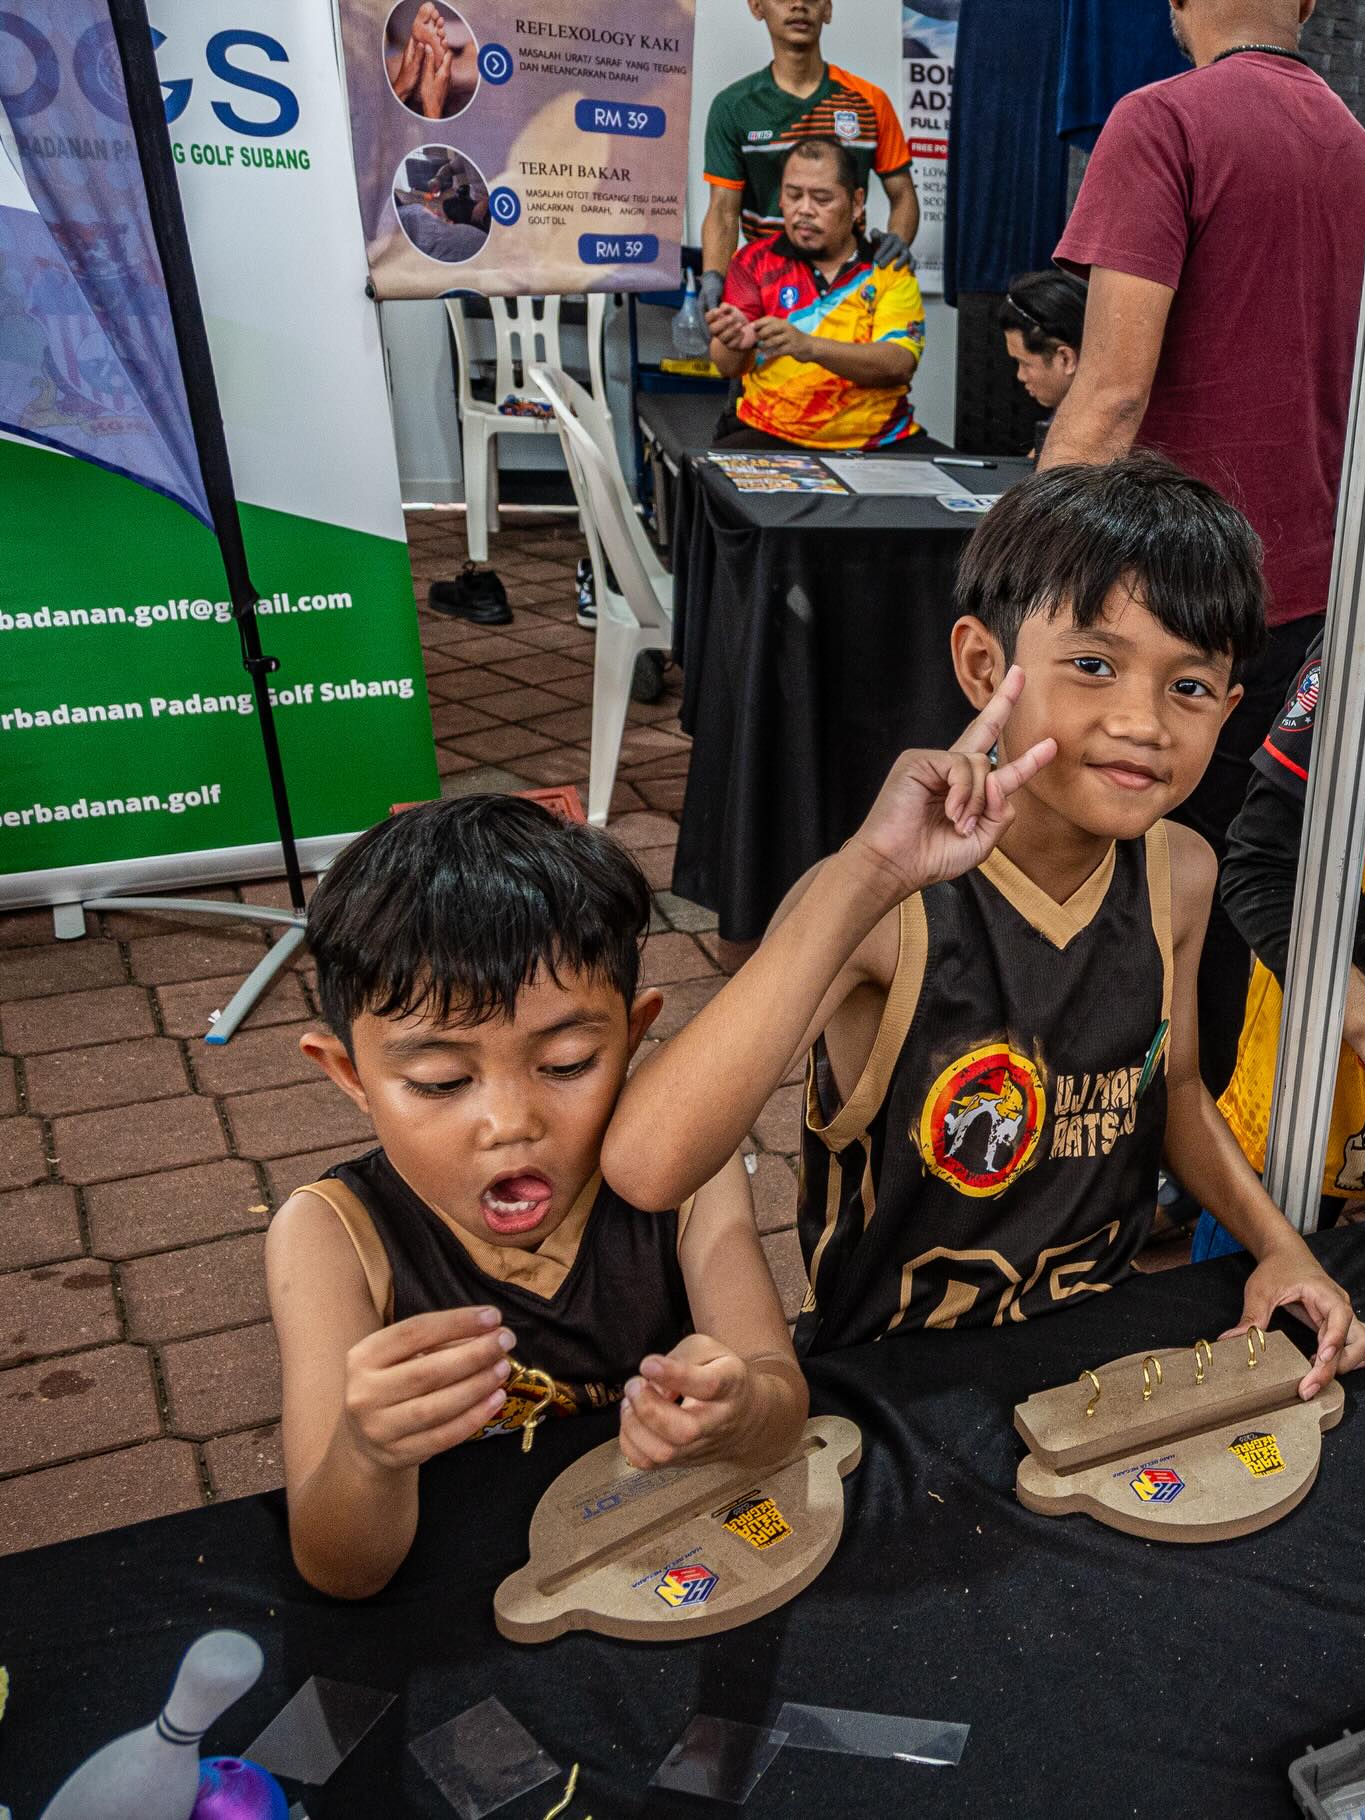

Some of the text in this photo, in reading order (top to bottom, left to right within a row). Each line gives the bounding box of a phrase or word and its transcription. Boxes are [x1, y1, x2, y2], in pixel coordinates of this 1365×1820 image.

[516, 19, 679, 52] REFLEXOLOGY KAKI
[519, 48, 687, 75] MASALAH URAT/ SARAF YANG TEGANG
[520, 62, 639, 83] DAN MELANCARKAN DARAH
[595, 108, 648, 130] RM 39
[911, 116, 940, 129] FULL
[191, 145, 234, 167] GOLF
[241, 148, 310, 170] SUBANG
[912, 143, 933, 152] FREE
[520, 162, 631, 182] TERAPI BAKAR
[526, 189, 564, 198] MASALAH
[567, 190, 589, 200] OTOT
[633, 194, 649, 204] TISU
[527, 204, 574, 213] LANCARKAN
[620, 208, 645, 216] ANGIN
[528, 217, 566, 225] GOUT DLL
[596, 241, 643, 257] RM 39
[150, 690, 254, 718] Padang
[320, 676, 414, 705] Subang
[0, 784, 222, 828] erbadanan.golf
[1050, 1111, 1120, 1158] ARTS
[1227, 1434, 1277, 1456] NEGARA
[1247, 1455, 1285, 1475] HARI
[722, 1498, 777, 1534] NEGARA
[747, 1518, 791, 1547] HARI
